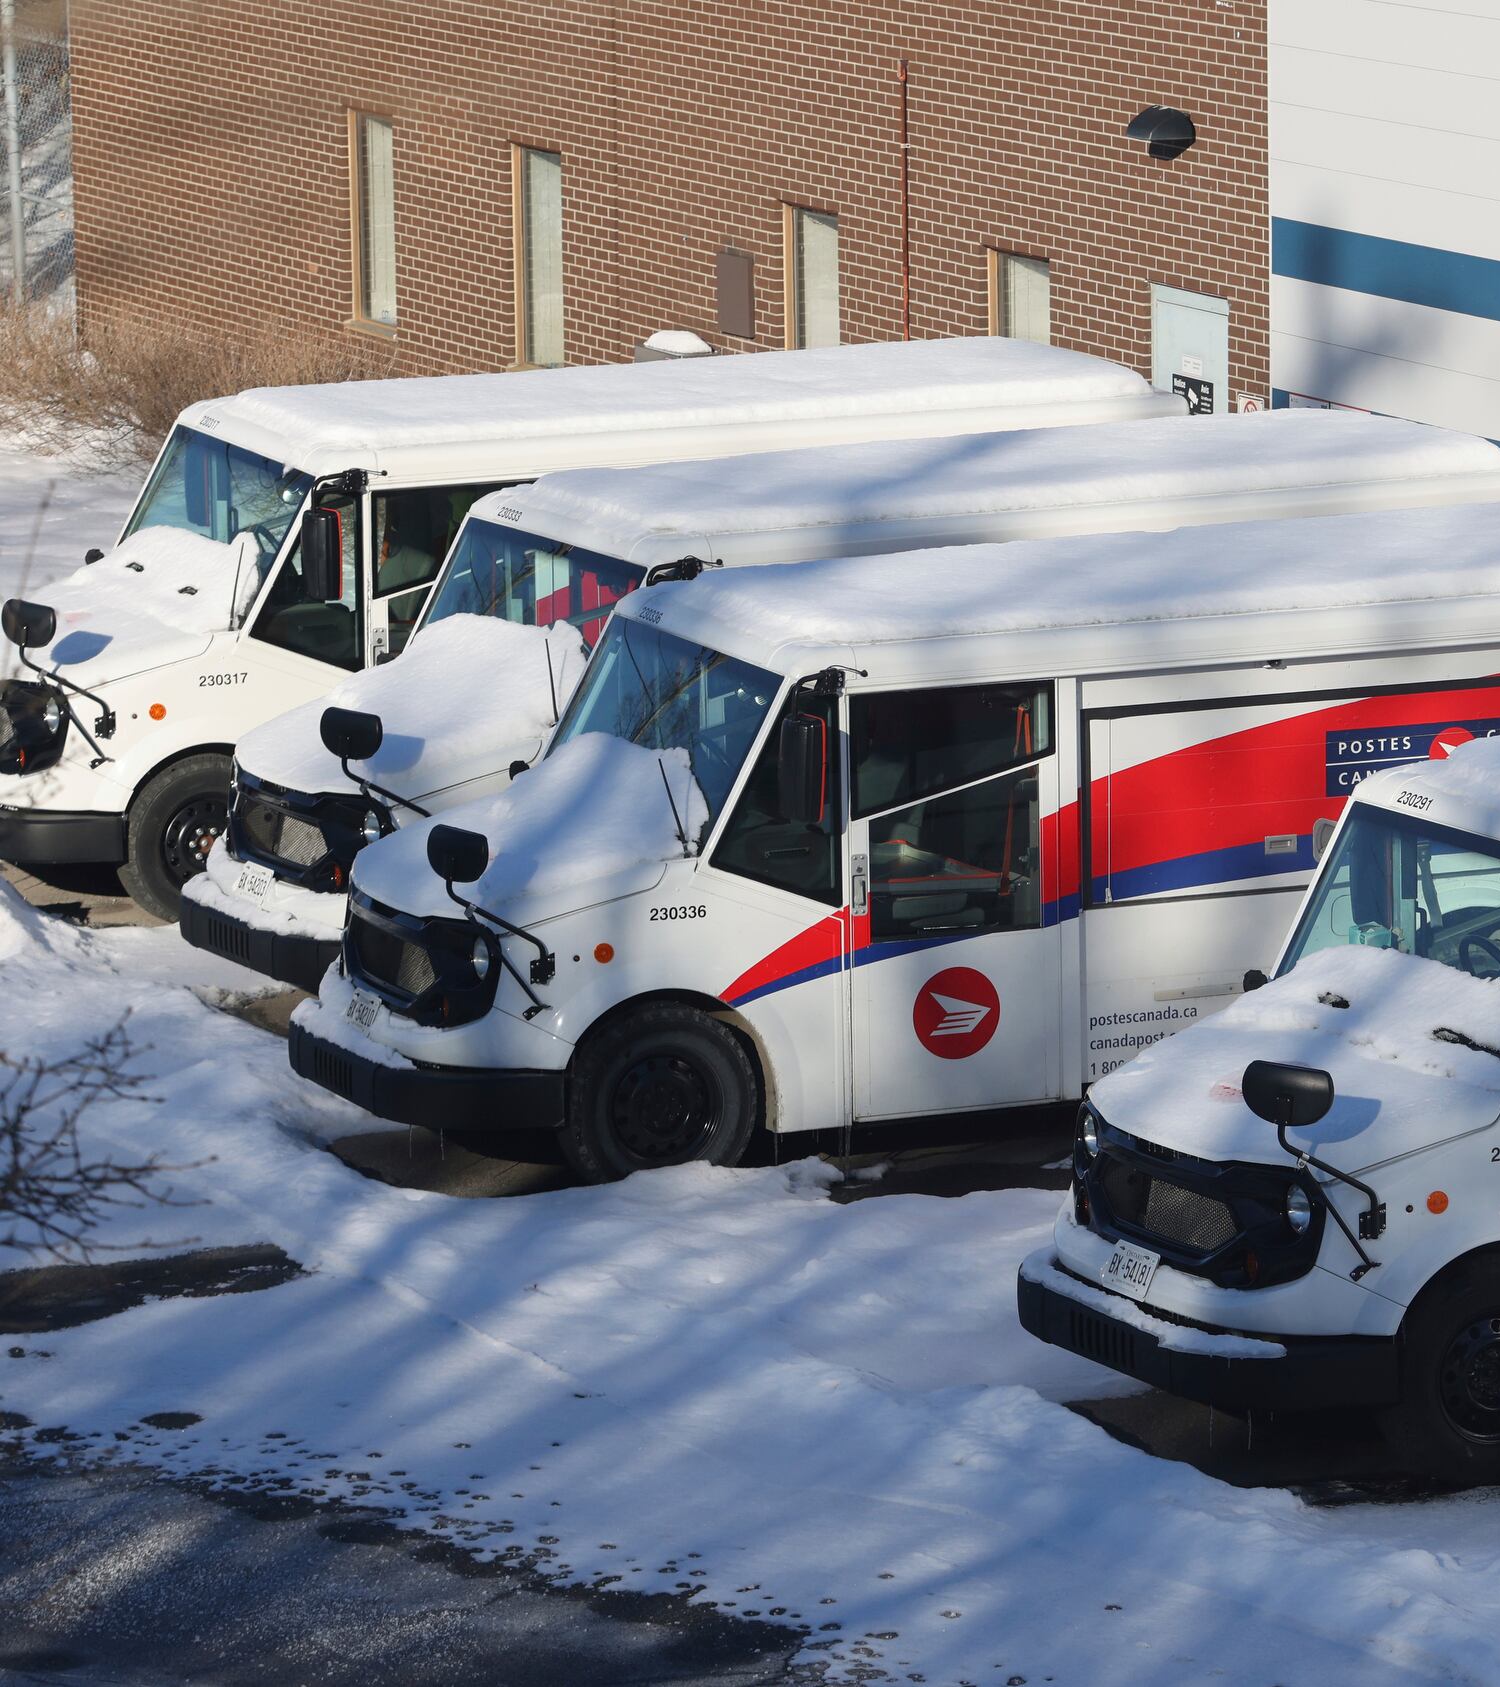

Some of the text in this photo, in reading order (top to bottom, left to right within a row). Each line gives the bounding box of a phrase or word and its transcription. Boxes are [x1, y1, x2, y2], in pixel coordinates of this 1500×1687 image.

[200, 415, 220, 430] 230317
[497, 507, 522, 522] 230333
[639, 606, 663, 625] 230336
[198, 672, 248, 687] 230317
[1338, 736, 1412, 755] POSTES
[1397, 789, 1434, 812] 230291
[650, 904, 707, 921] 230336
[1089, 1005, 1197, 1031] postescanada.ca
[1090, 1062, 1096, 1076] 1
